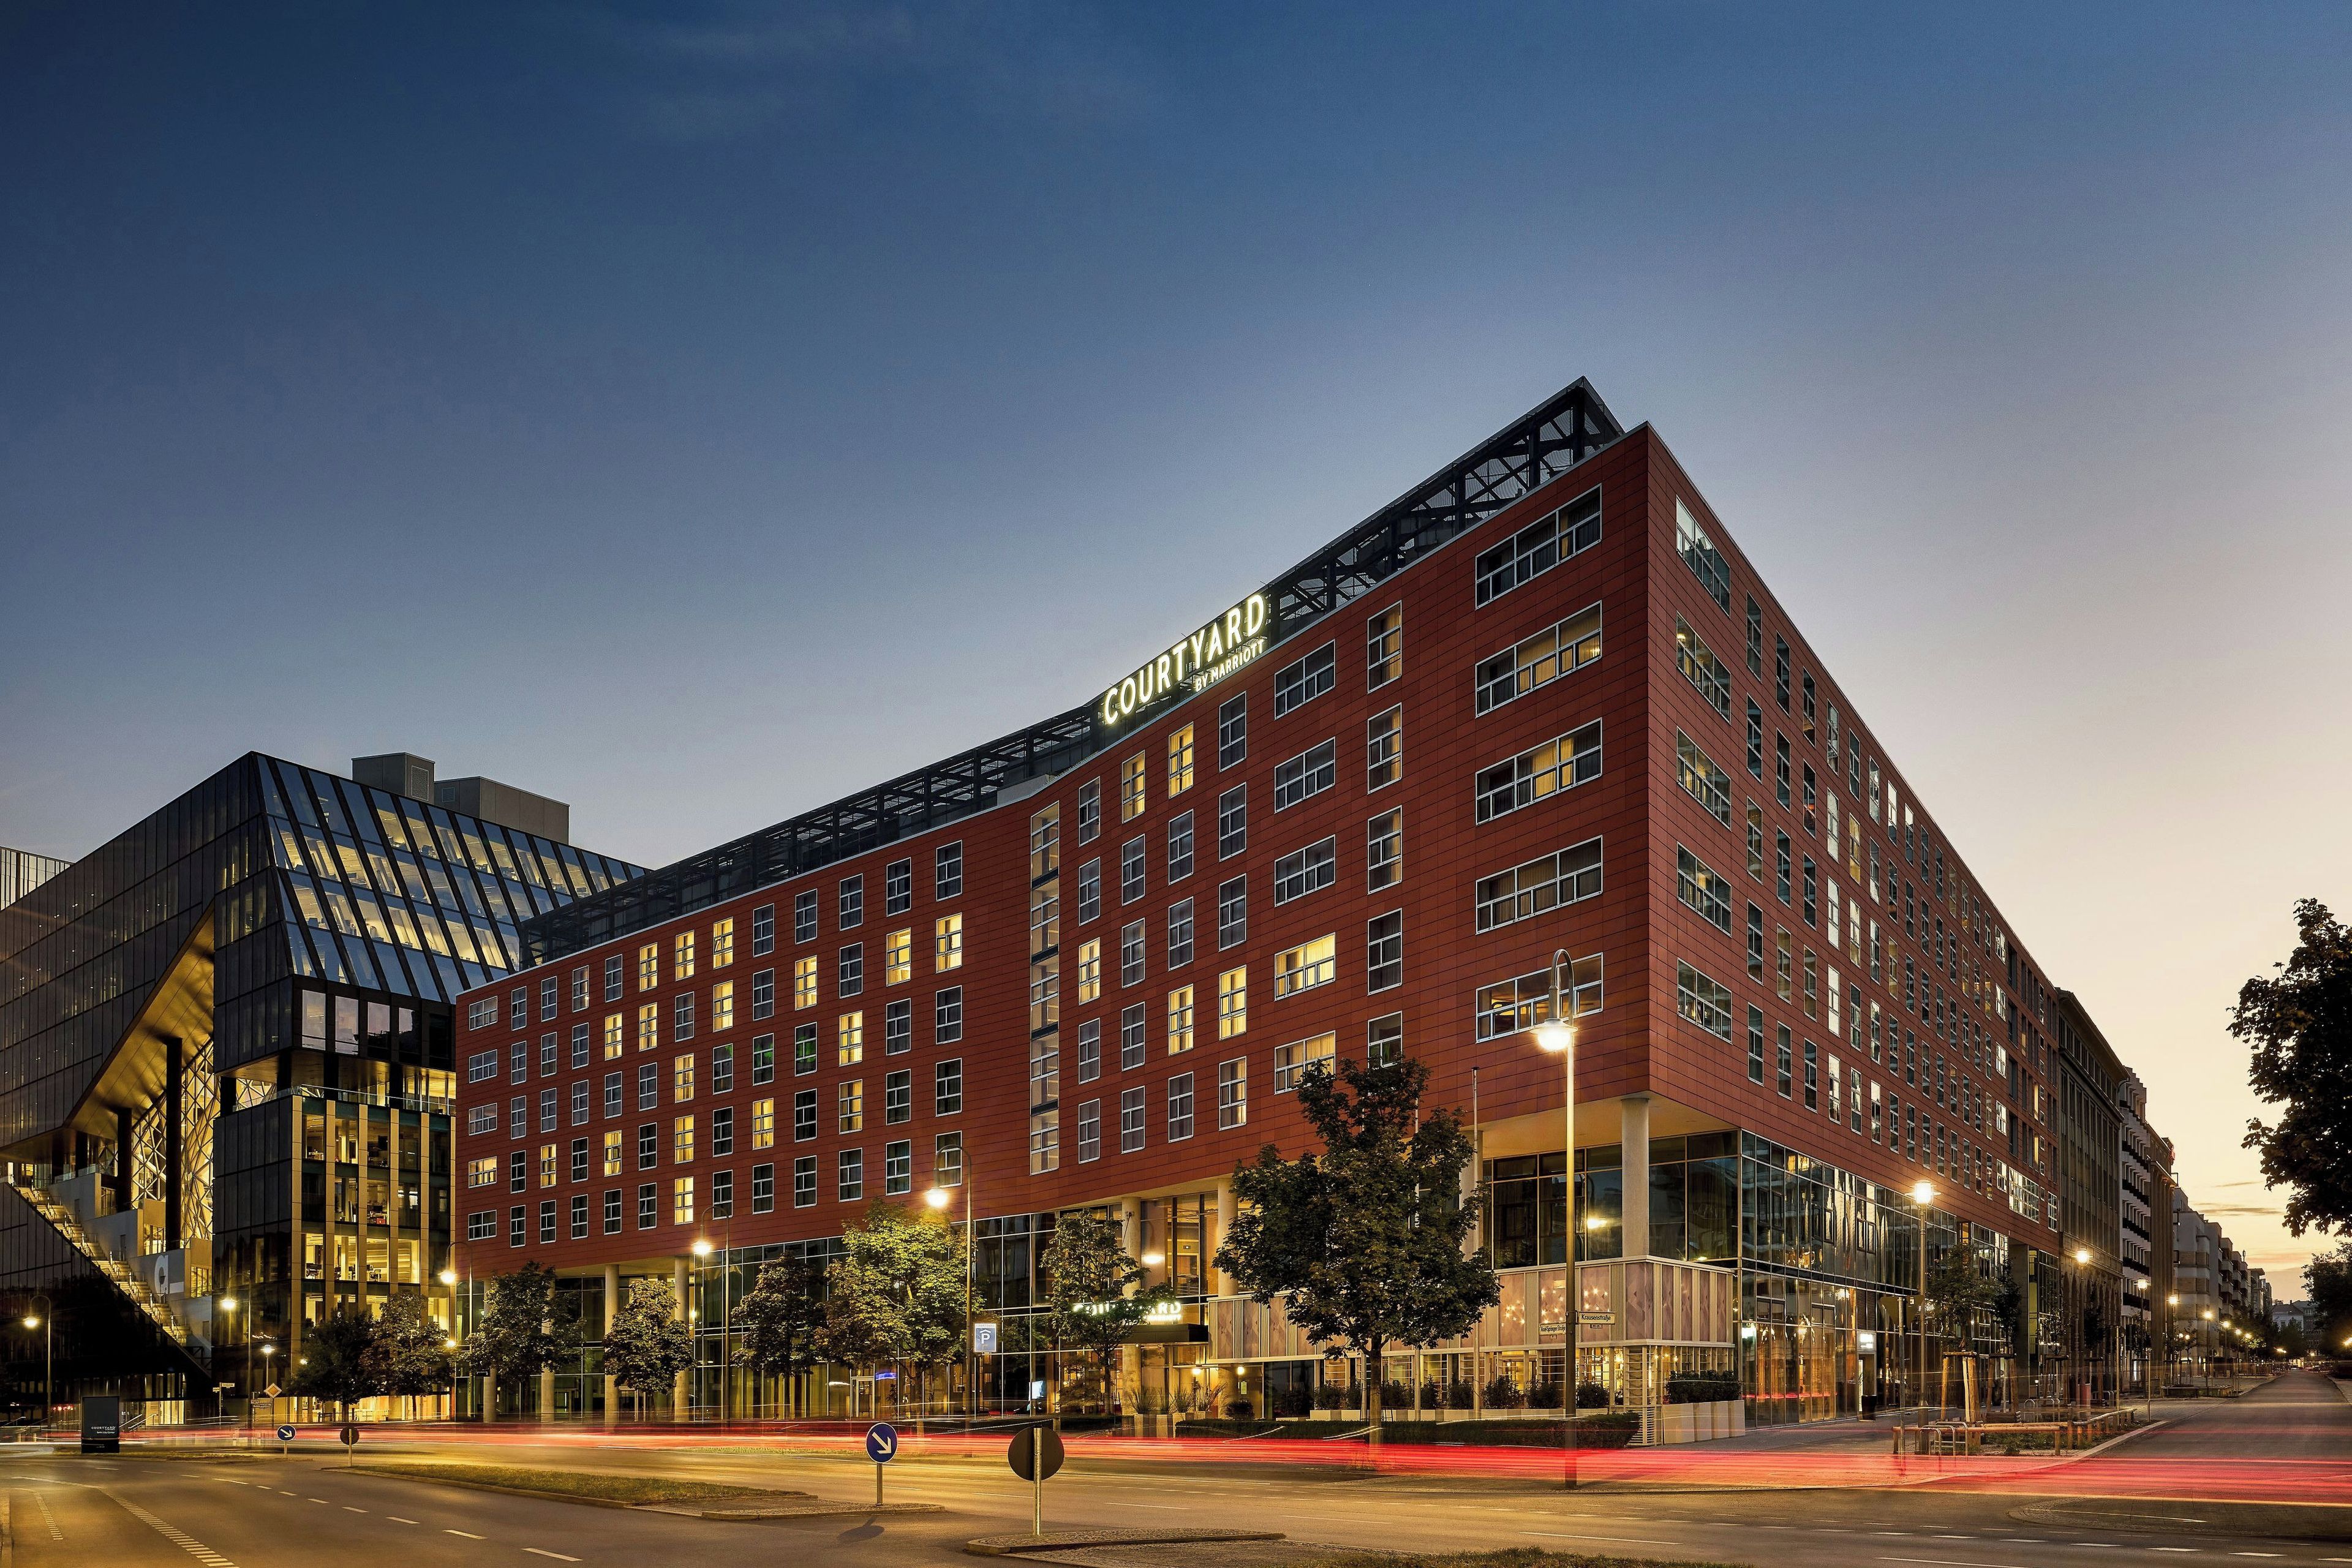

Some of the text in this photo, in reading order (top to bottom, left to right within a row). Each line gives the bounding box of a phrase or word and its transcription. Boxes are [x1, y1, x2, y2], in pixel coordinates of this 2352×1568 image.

[1104, 594, 1264, 725] COURTYARD
[1196, 639, 1264, 693] BY MARRIOTT
[981, 1333, 990, 1344] P
